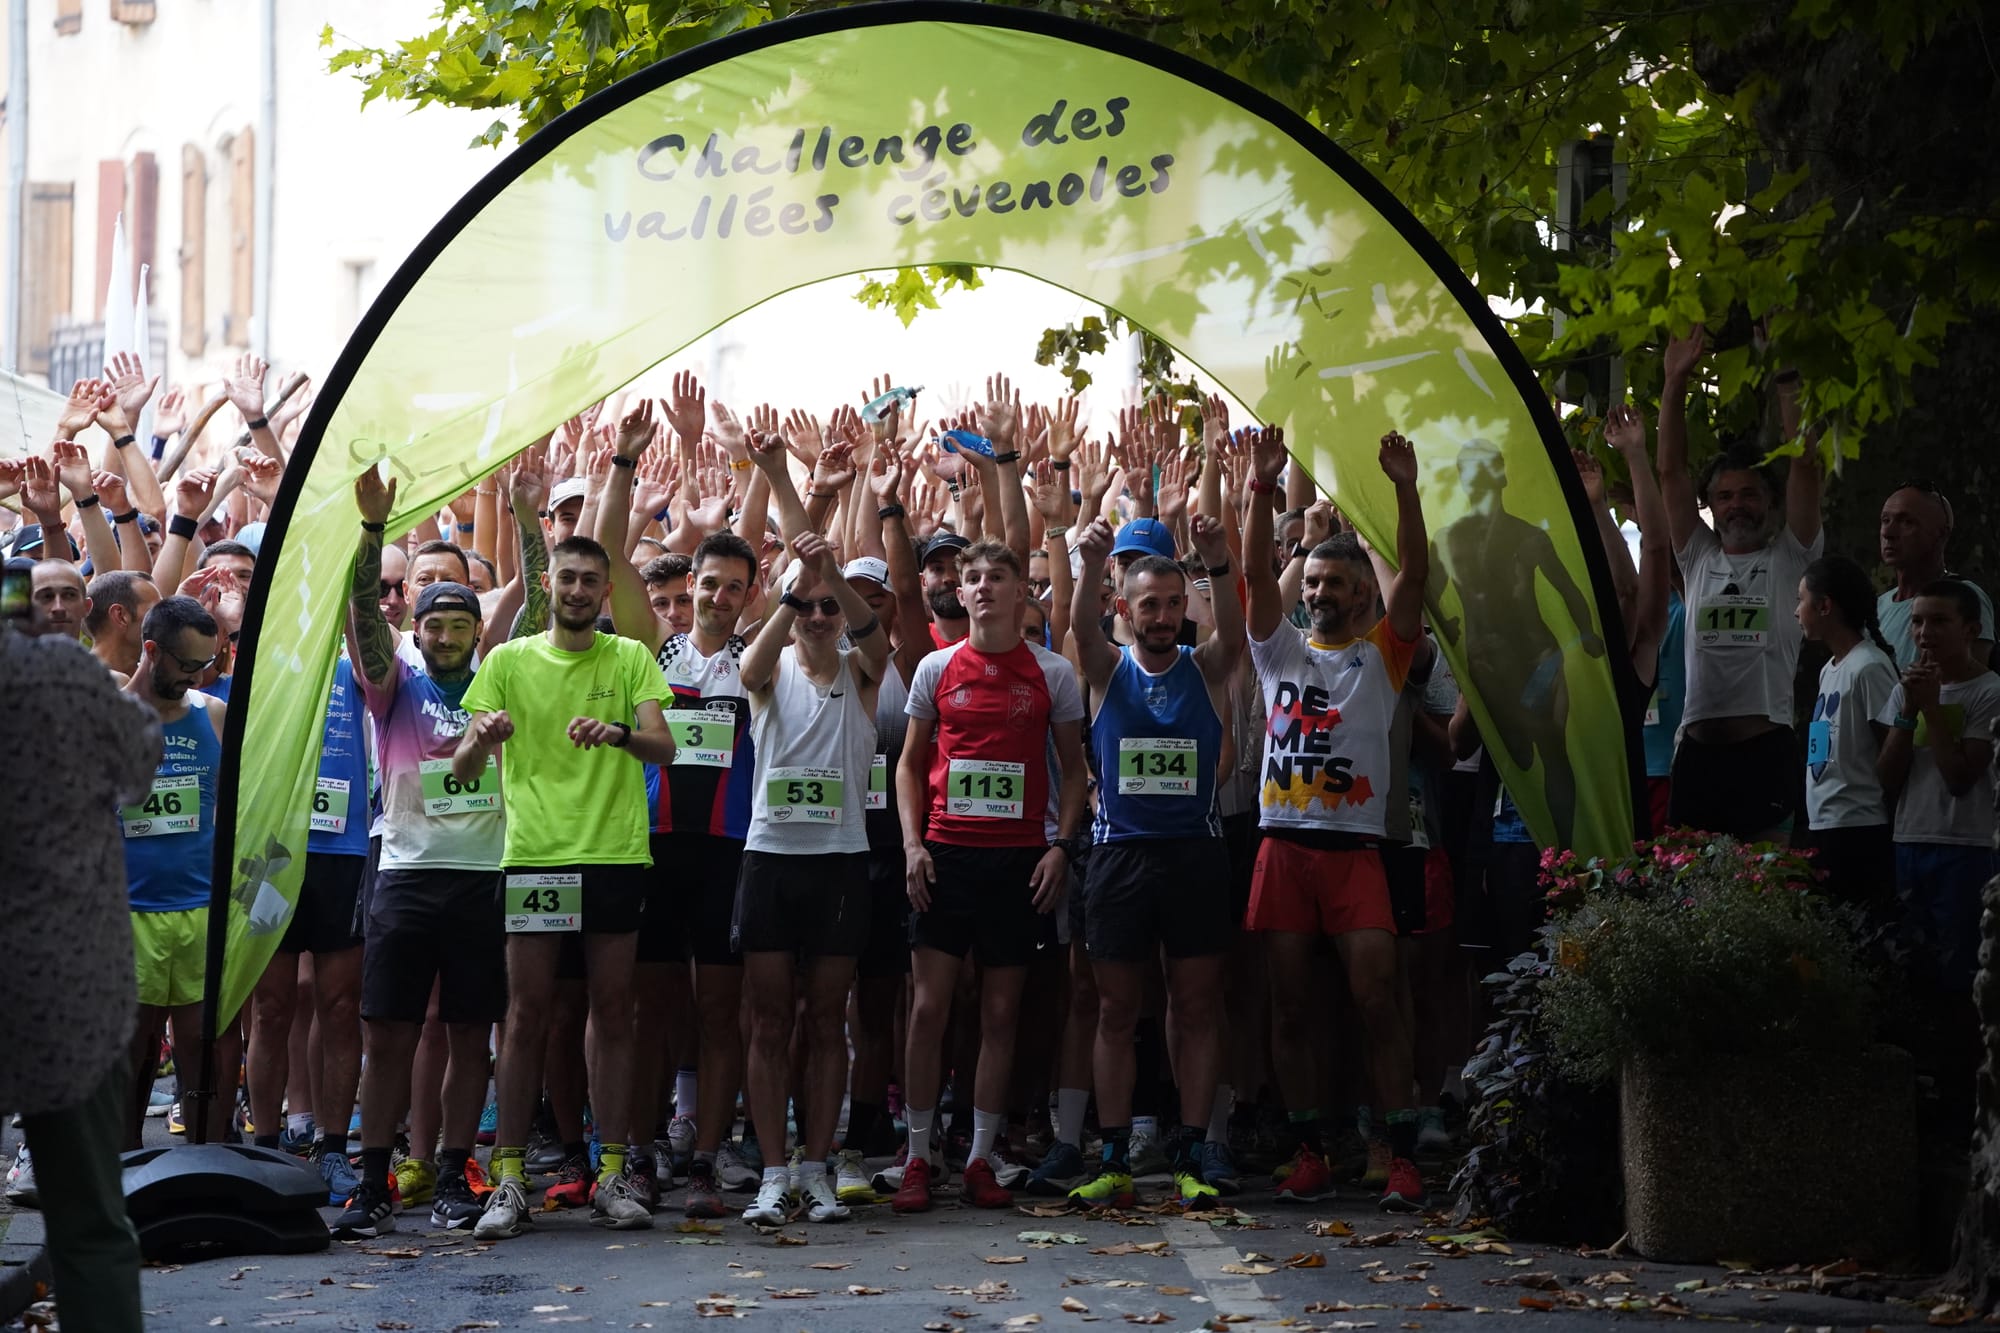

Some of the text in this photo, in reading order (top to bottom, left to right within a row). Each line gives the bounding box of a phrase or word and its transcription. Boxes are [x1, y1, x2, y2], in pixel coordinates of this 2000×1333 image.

[637, 97, 1130, 181] Challenge des
[605, 154, 1174, 242] vallées cévenoles
[1708, 608, 1758, 629] 117
[1275, 681, 1330, 716] DE
[165, 735, 198, 750] UZE
[685, 724, 703, 747] 3
[1270, 718, 1331, 754] ME
[1811, 738, 1817, 754] 5
[1131, 752, 1187, 776] 134
[1265, 755, 1354, 793] NTS
[787, 781, 824, 804] 53
[959, 774, 1013, 799] 113
[143, 792, 181, 816] 46
[522, 889, 560, 912] 43
